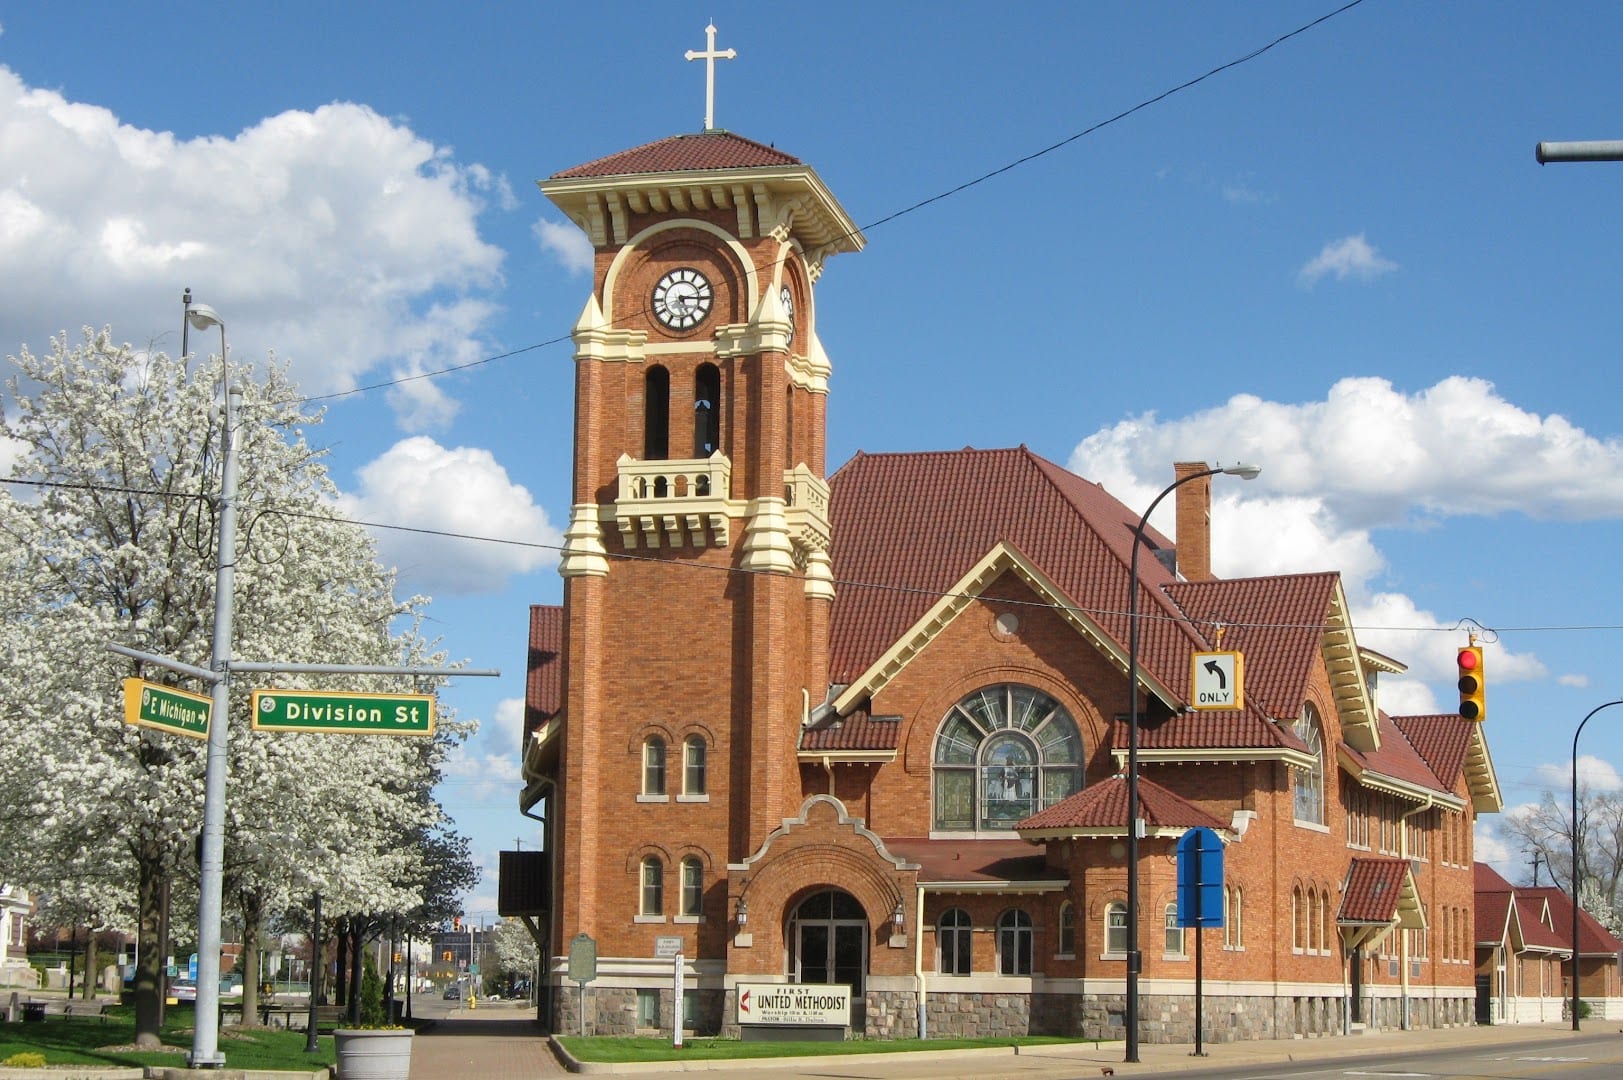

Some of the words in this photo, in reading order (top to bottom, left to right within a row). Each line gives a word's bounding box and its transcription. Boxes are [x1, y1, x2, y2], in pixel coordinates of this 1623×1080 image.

[1200, 692, 1229, 702] ONLY
[150, 697, 157, 714] E
[160, 699, 196, 726] Michigan
[286, 703, 382, 722] Division
[395, 706, 419, 723] St
[758, 995, 791, 1009] UNITED
[795, 996, 846, 1010] METHODIST
